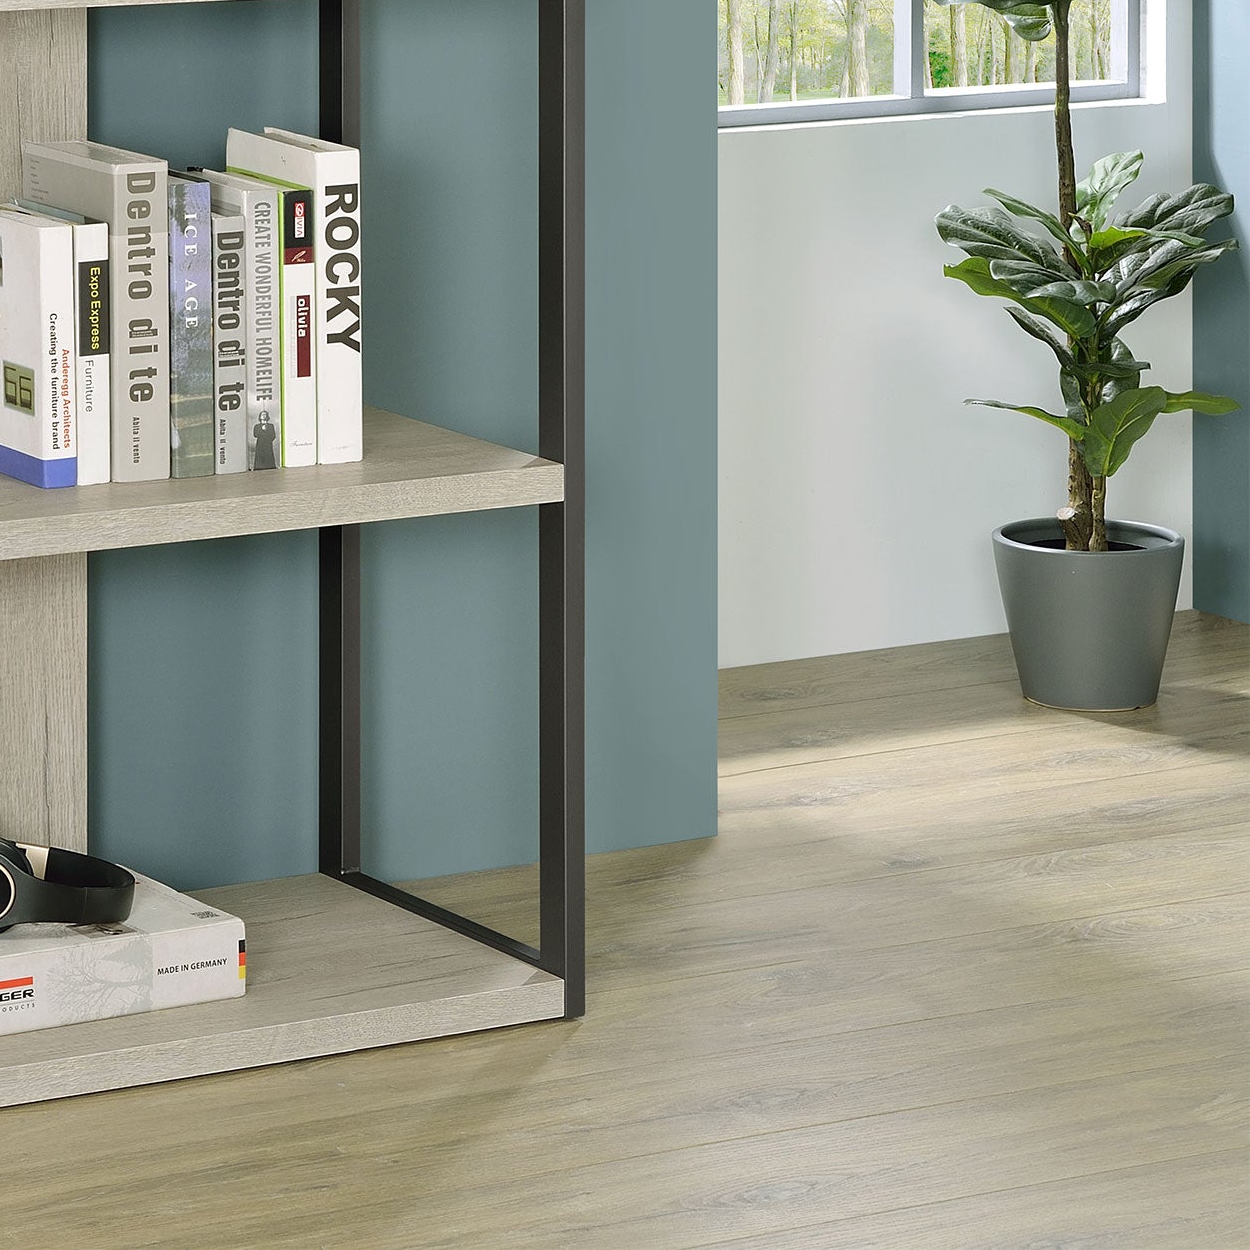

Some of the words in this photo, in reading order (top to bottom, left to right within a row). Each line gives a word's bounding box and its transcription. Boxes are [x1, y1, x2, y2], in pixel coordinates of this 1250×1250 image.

[127, 172, 156, 300] Dentro
[184, 213, 198, 256] ICE
[254, 202, 271, 252] CREATE
[88, 267, 100, 298] Expo
[217, 232, 244, 330] Dentro
[324, 183, 361, 353] ROCKY
[184, 279, 198, 329] AGE
[254, 256, 271, 335] WONDERFUL
[48, 313, 58, 355] Creating
[88, 302, 100, 349] Express
[128, 318, 158, 355] di
[298, 298, 309, 338] olivia
[51, 358, 59, 374] the
[61, 349, 71, 397] Anderegg
[218, 340, 246, 367] di
[256, 338, 272, 401] HOMELIFE
[51, 377, 60, 418] furniture
[85, 360, 94, 412] Furniture
[128, 366, 157, 402] te
[218, 380, 244, 412] te
[52, 422, 60, 450] brand
[62, 398, 71, 449] Architects
[132, 416, 140, 434] Abita
[132, 444, 140, 464] vento
[157, 966, 179, 976] MADE
[180, 964, 189, 972] IN
[190, 958, 228, 970] GERMANY
